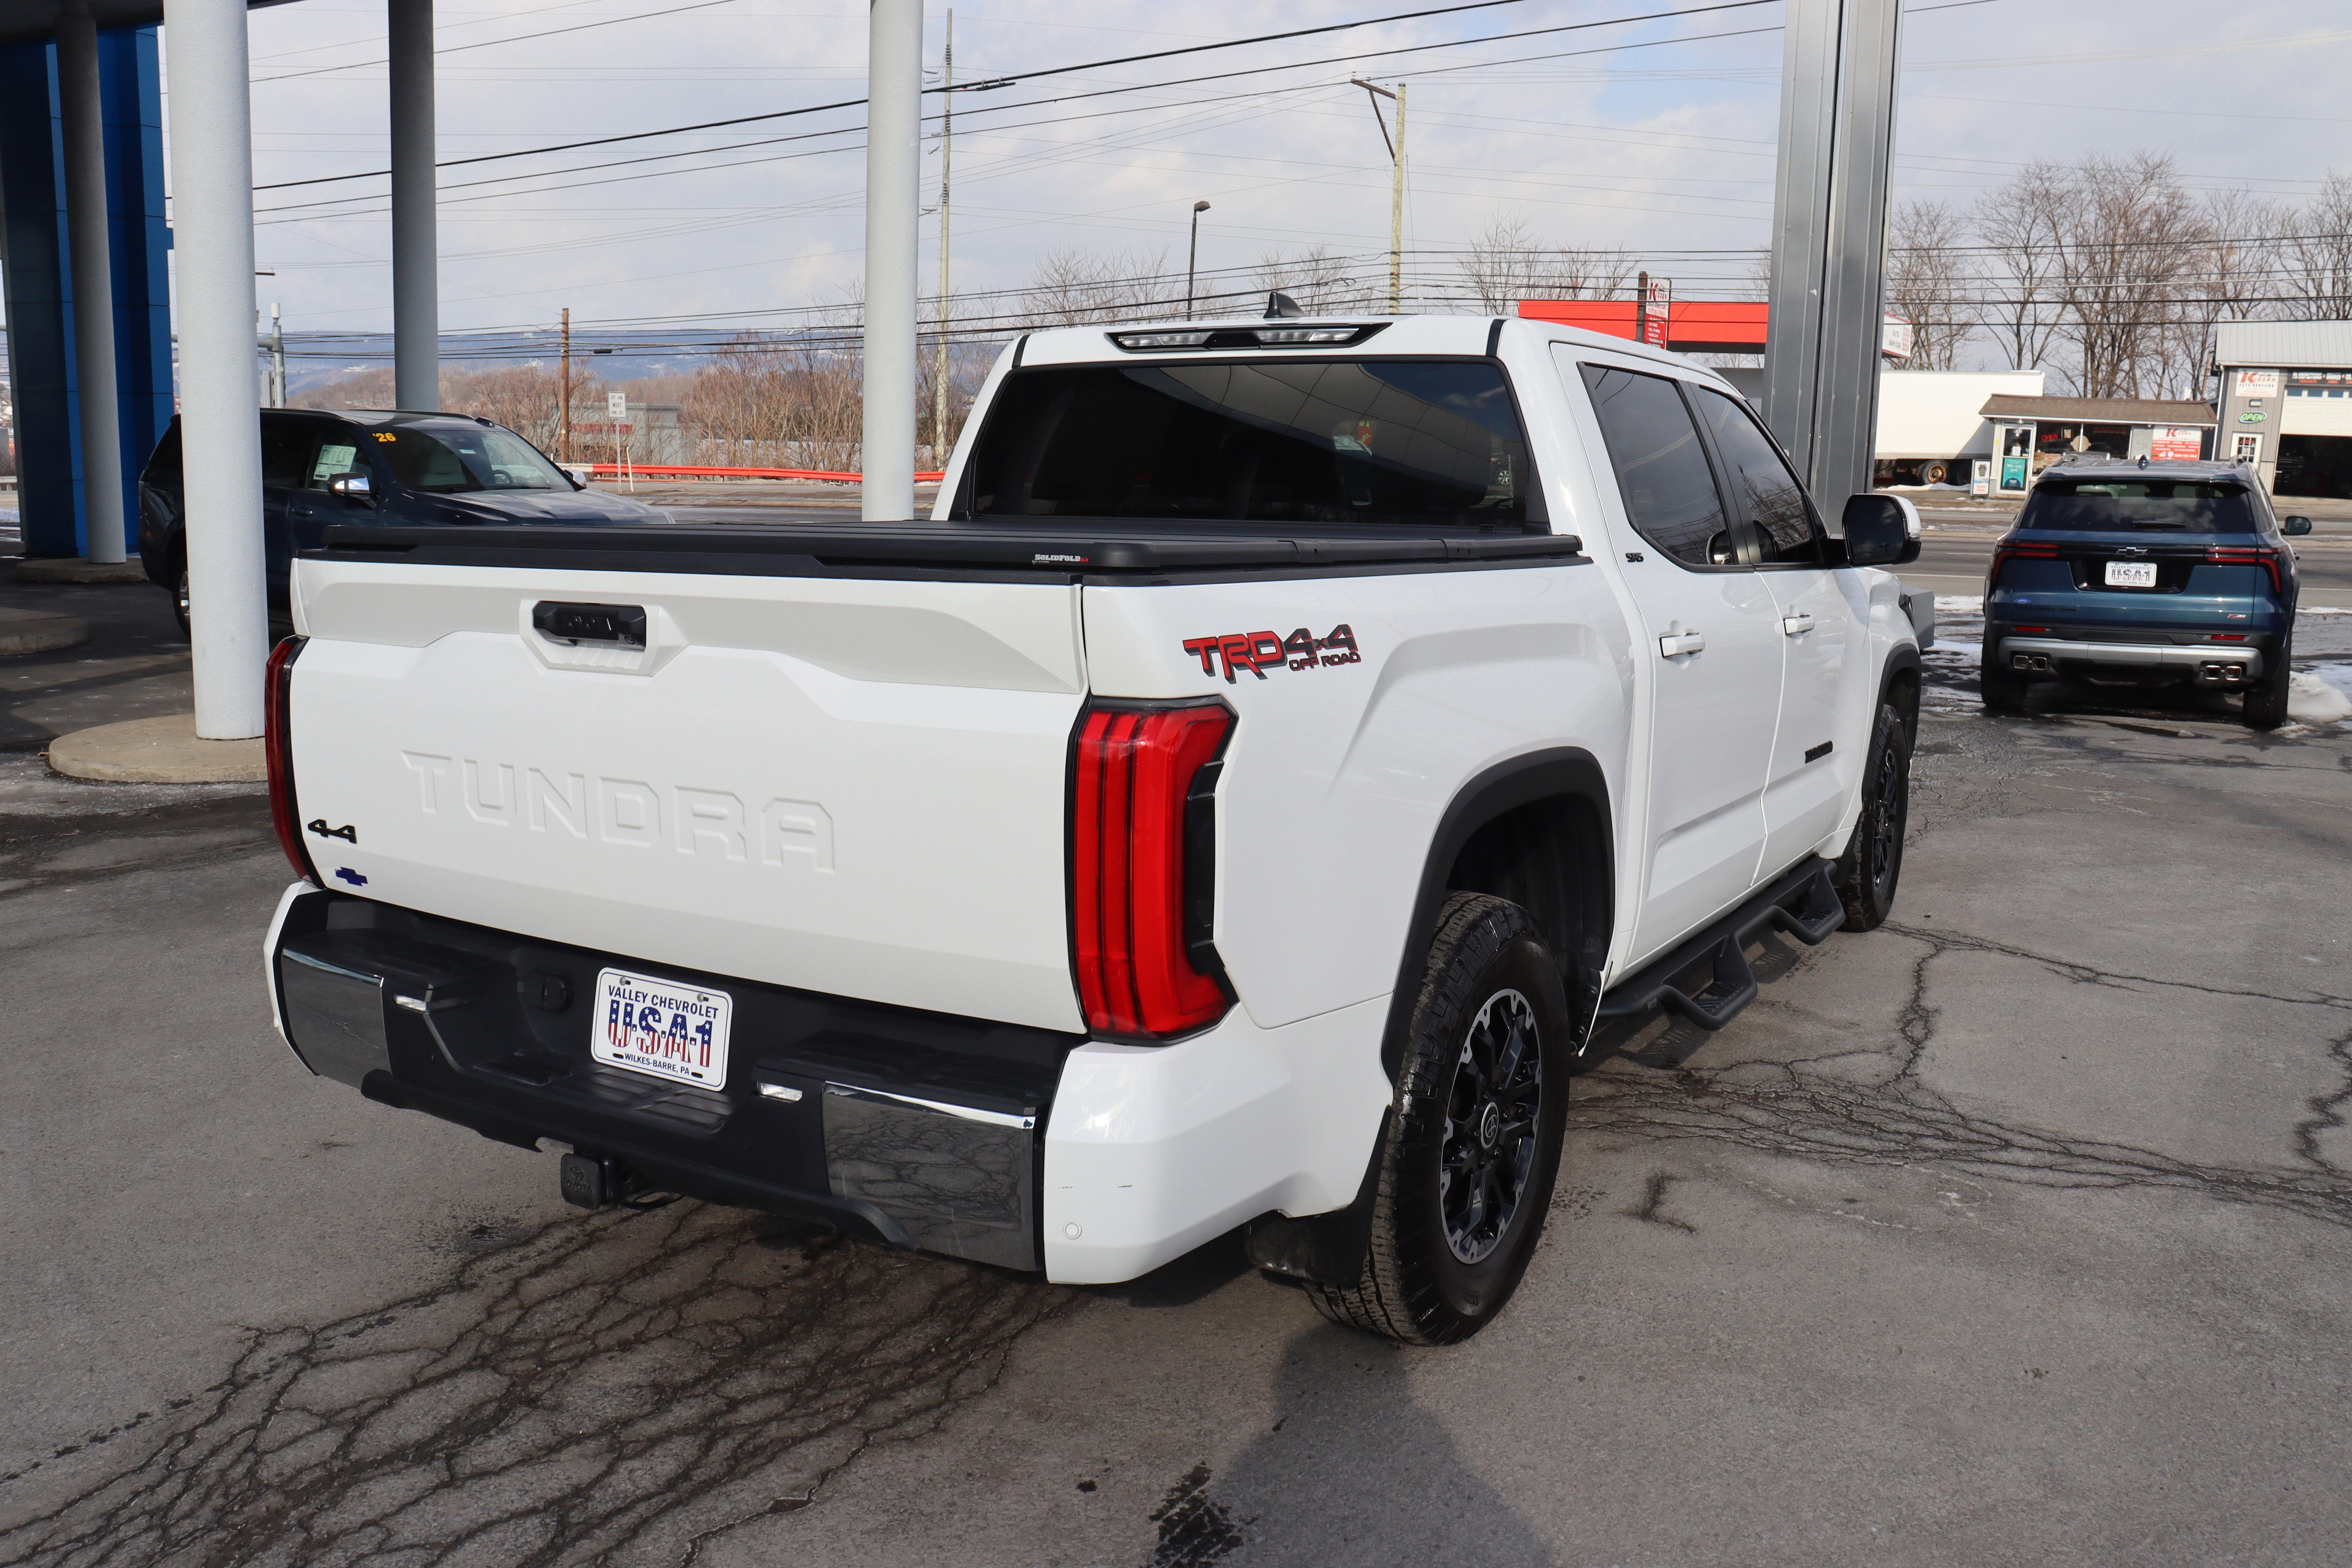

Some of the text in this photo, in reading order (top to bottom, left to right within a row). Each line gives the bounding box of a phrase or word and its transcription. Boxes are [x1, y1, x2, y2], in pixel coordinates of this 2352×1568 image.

[2042, 433, 2059, 441] OPEN
[1034, 554, 1081, 562] SOLIDFOLD
[1626, 552, 1644, 562] SR5
[1183, 631, 1287, 684] TRD
[1289, 651, 1361, 671] OFF ROAD
[401, 750, 835, 874] TUNDRA
[608, 985, 719, 1019] VALLEY CHEVROLET
[625, 1053, 690, 1075] WILKES-BARRE, PA
